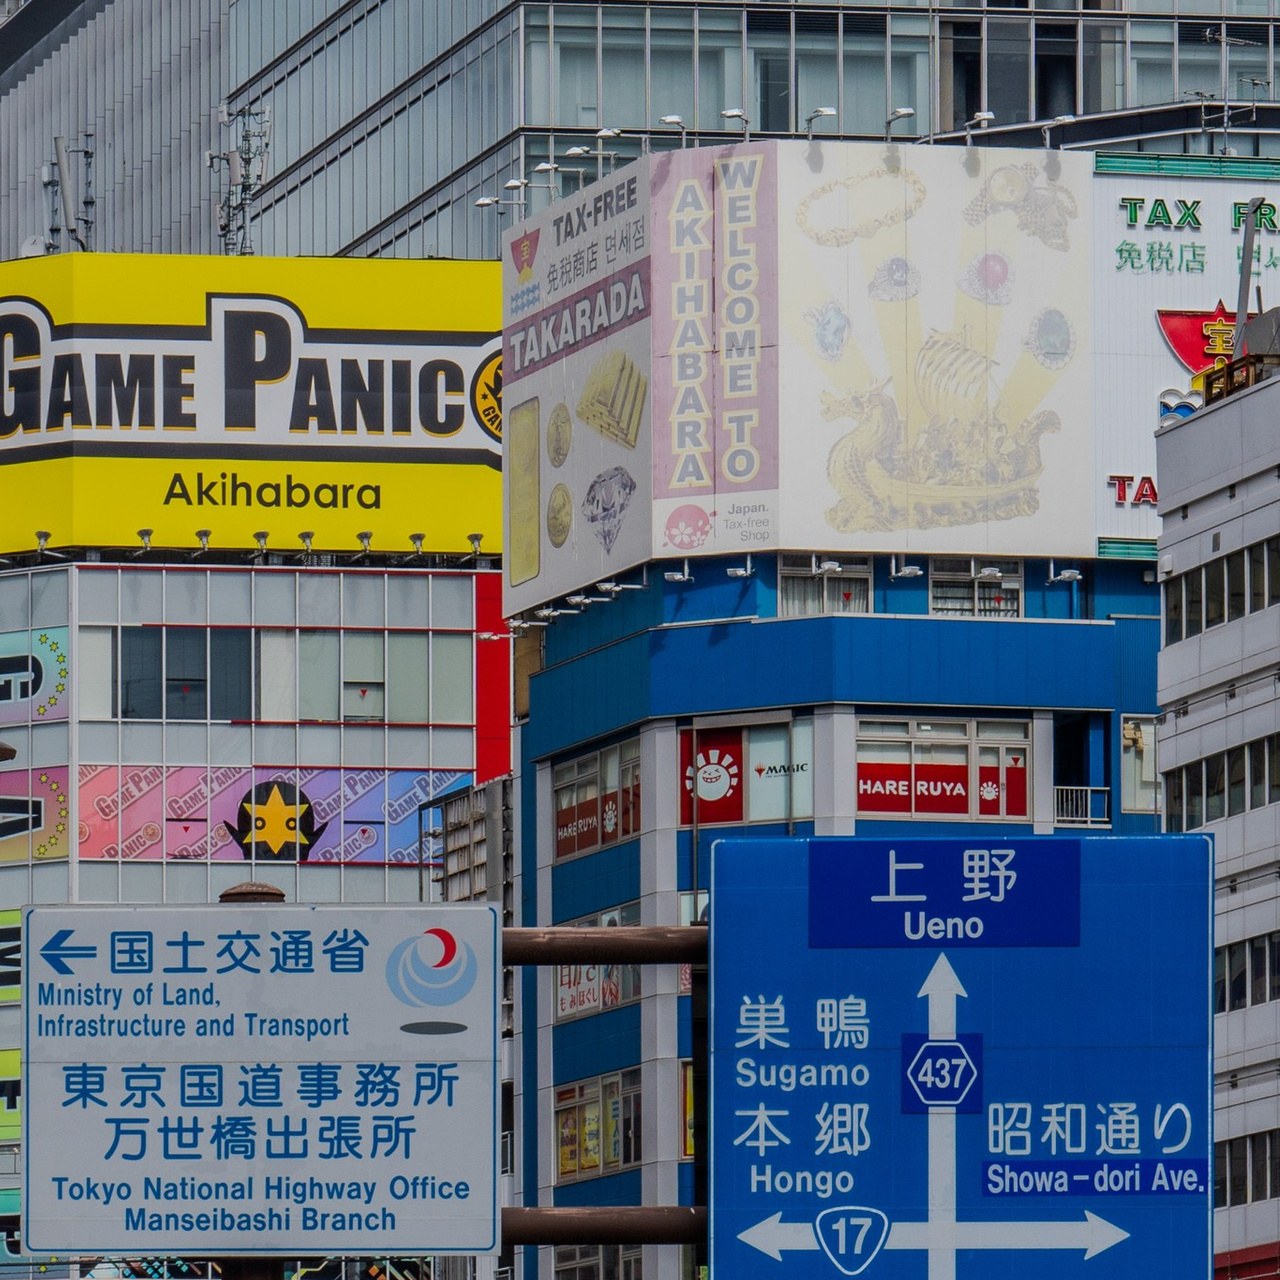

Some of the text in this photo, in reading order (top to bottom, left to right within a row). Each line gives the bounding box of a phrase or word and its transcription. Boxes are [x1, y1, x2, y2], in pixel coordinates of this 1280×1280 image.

[552, 175, 639, 248] TAX-FREE
[1120, 197, 1280, 231] TAX FR
[546, 241, 600, 296] 免税商店
[1114, 239, 1207, 274] 免税店
[509, 271, 646, 374] TAKARADA
[673, 184, 710, 486] AKIHABARA
[720, 158, 762, 482] WELCOME TO
[222, 309, 466, 438] PANIC
[163, 472, 382, 510] Akihabara
[726, 502, 770, 518] Japan.
[739, 529, 770, 544] Shop
[765, 761, 809, 774] MAGIC
[858, 780, 966, 797] HARE RUYA
[870, 849, 1018, 902] 上野
[904, 911, 985, 941] Ueno
[111, 928, 370, 975] 国土交通省
[37, 982, 221, 1011] Ministry of Land,
[37, 1013, 349, 1042] Infrastructure and Transport
[734, 995, 871, 1051] 巣鴨
[61, 1062, 460, 1109] 東京国道事務所
[735, 1058, 871, 1091] Sugamo
[917, 1058, 967, 1089] 437
[103, 1114, 417, 1161] 万世橋出張所
[733, 1102, 872, 1157] 本郷
[988, 1102, 1193, 1157] 昭和通り
[51, 1175, 471, 1206] Tokyo National Highway Office
[749, 1164, 855, 1198] Hongo
[1151, 1162, 1206, 1194] Ave.
[124, 1207, 397, 1232] Manseibashi Branch
[831, 1217, 873, 1256] 17
